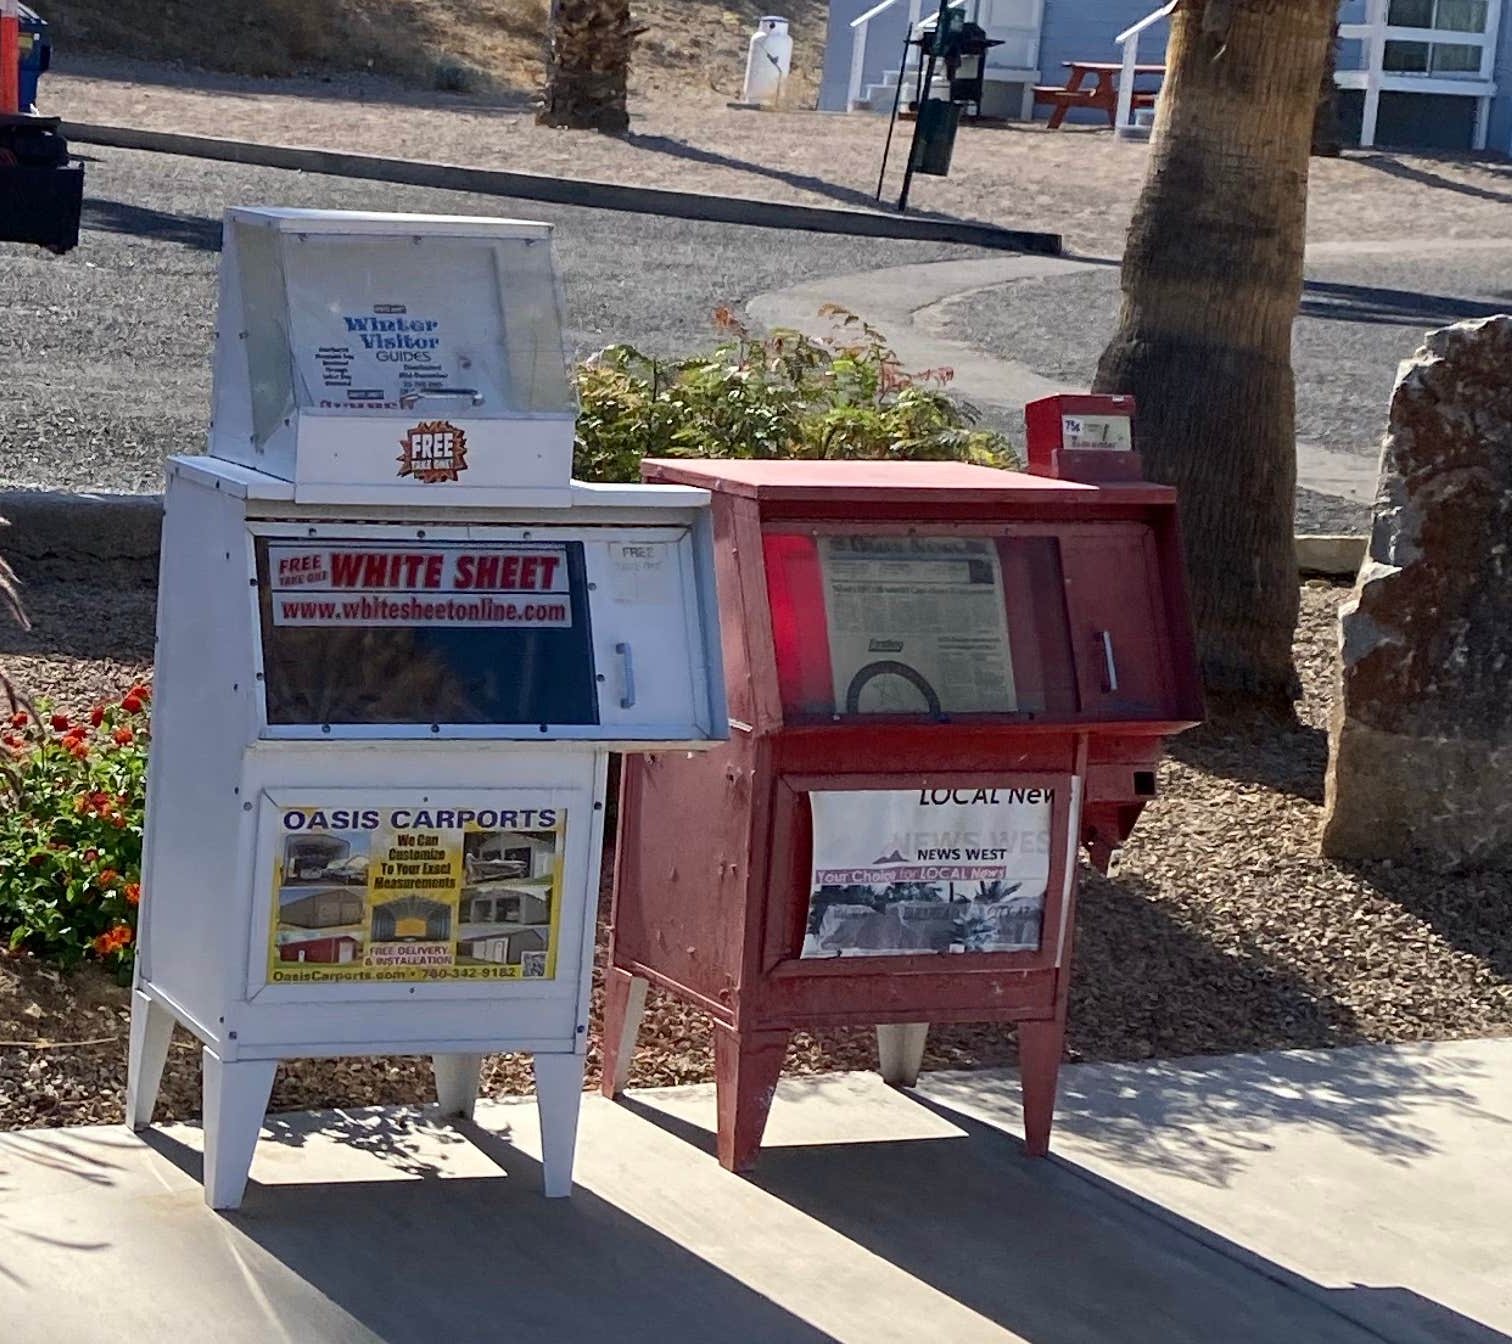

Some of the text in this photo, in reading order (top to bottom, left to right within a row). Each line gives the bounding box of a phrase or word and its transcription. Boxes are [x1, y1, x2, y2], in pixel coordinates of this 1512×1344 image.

[343, 317, 438, 332] Winter
[360, 334, 439, 349] Visitor
[376, 350, 431, 362] GUIDES
[411, 432, 454, 459] FREE
[622, 546, 655, 559] FREE
[279, 555, 321, 574] FREE
[330, 553, 560, 590] WHITE SHEET
[281, 596, 566, 621] www.whitesheetonline.com
[919, 789, 1000, 805] LOCAL
[283, 808, 556, 830] OASIS CARPORTS
[397, 834, 439, 847] We Can
[389, 847, 445, 860] Customize
[917, 847, 1007, 860] NEWS WEST
[381, 863, 394, 875] To
[396, 863, 420, 875] Your
[817, 866, 1006, 885] Your Choice for LOCAL News
[374, 876, 456, 890] Measurements
[370, 944, 449, 956] FREE DELIVERY
[375, 955, 453, 966] INSTALLATION
[273, 969, 405, 982] OasisCarports.com
